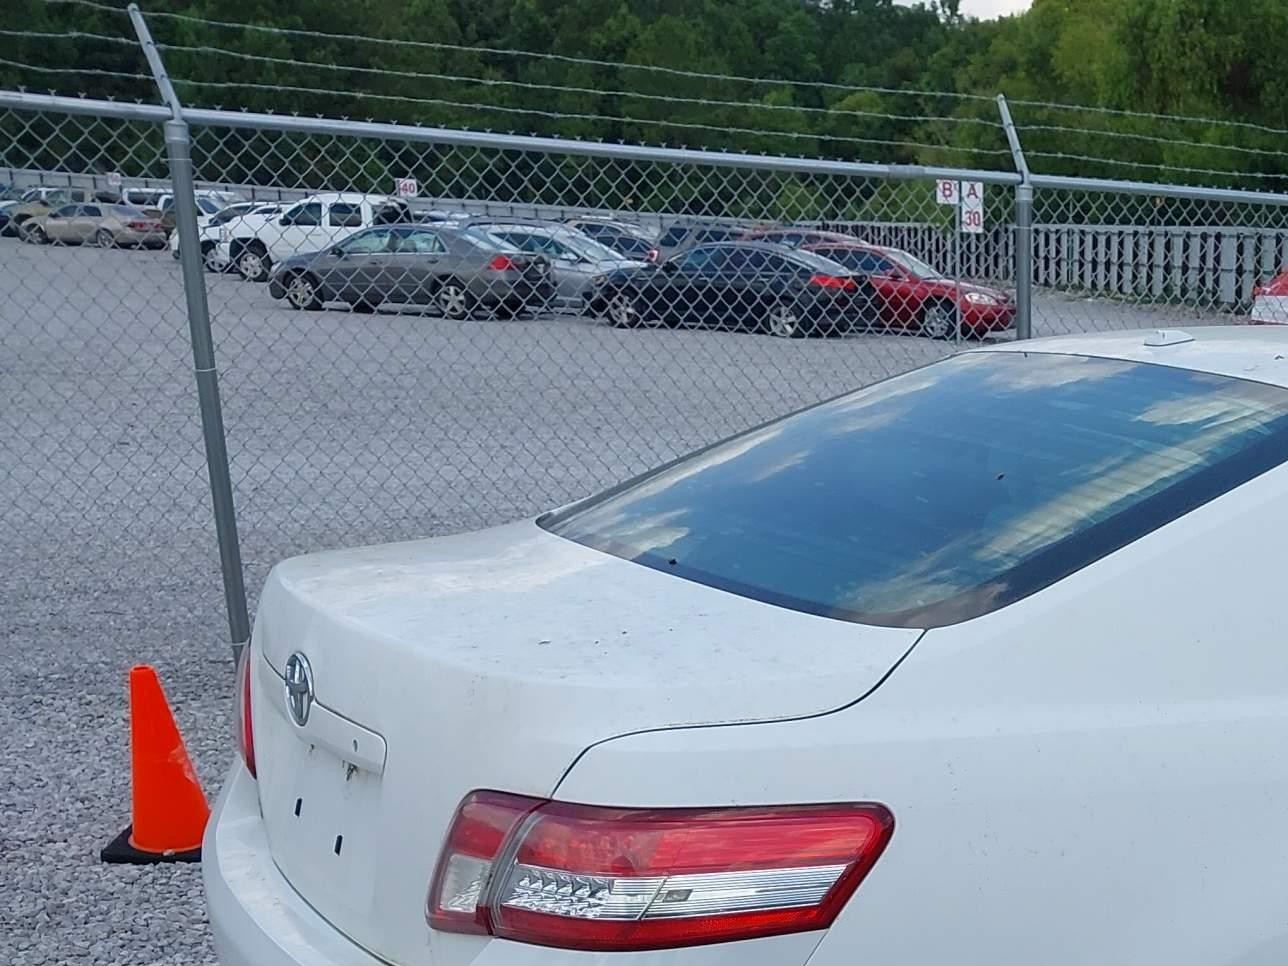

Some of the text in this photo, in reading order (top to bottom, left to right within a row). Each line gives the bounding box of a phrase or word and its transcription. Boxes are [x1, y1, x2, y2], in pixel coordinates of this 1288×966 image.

[402, 183, 415, 194] 40
[942, 181, 953, 198] B
[967, 183, 979, 199] A
[964, 210, 981, 226] 30
